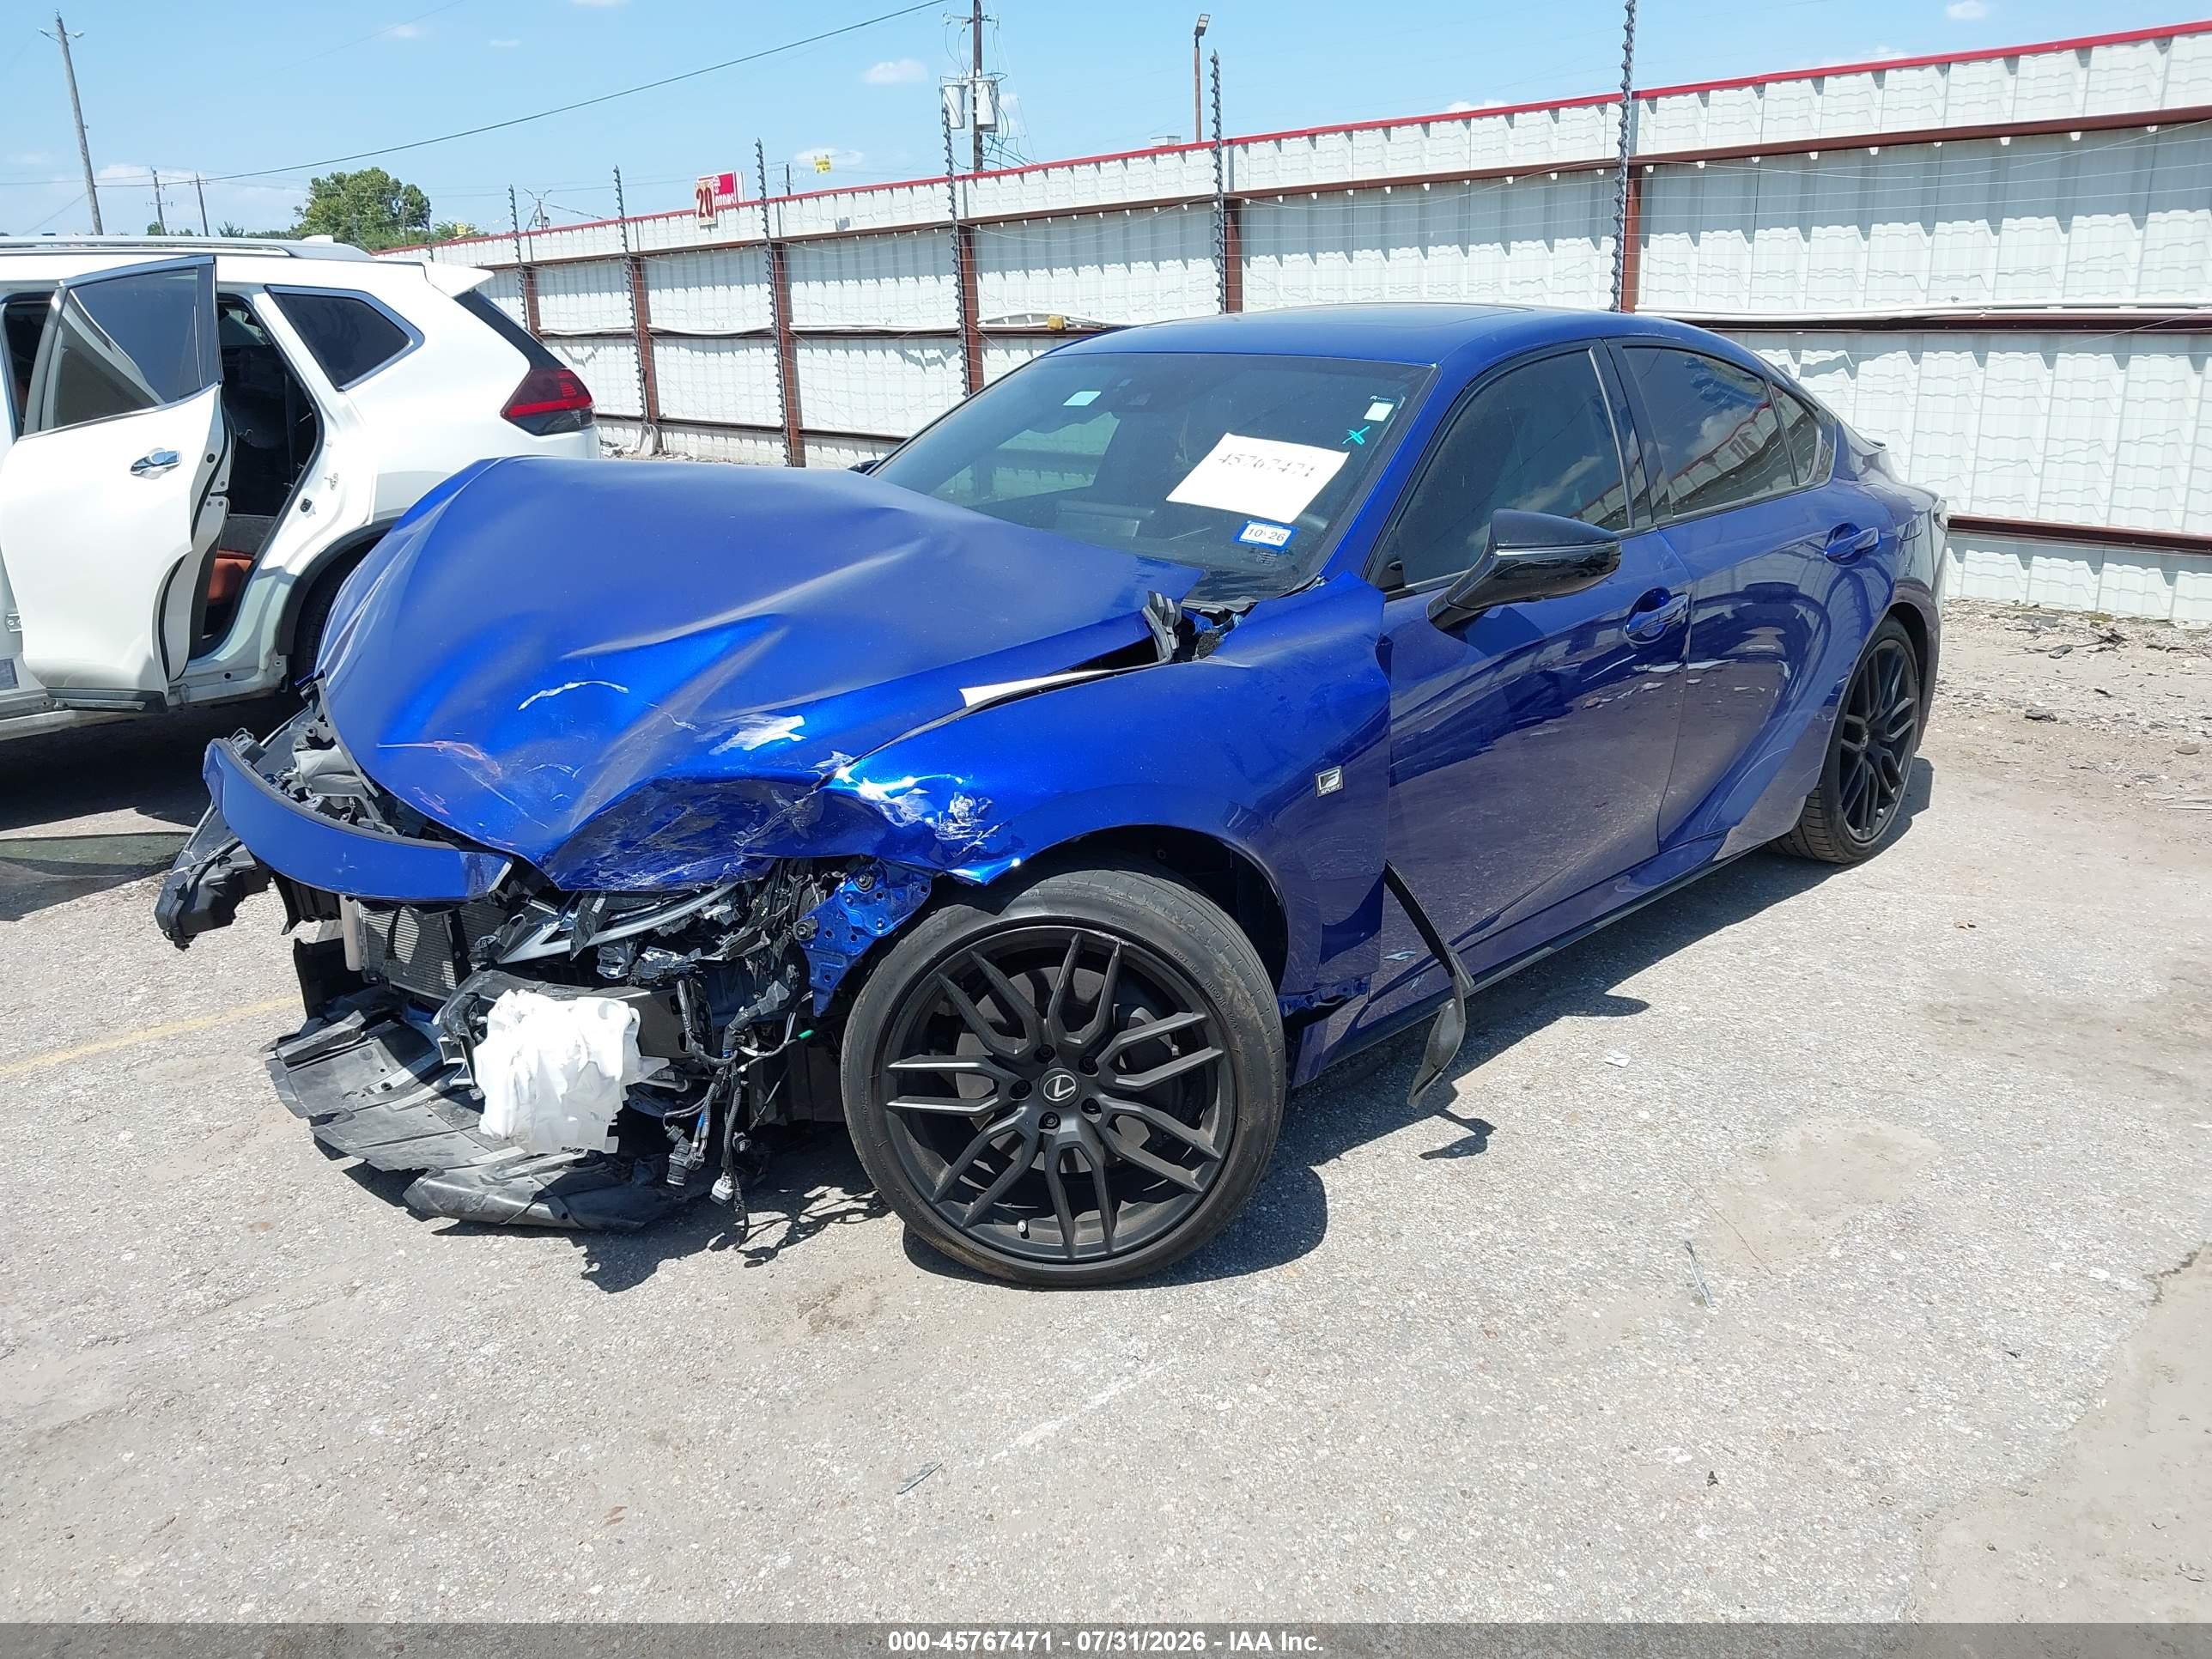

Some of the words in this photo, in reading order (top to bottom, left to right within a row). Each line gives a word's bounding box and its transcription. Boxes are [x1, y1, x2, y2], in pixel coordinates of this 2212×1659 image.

[696, 186, 714, 218] 20
[714, 192, 736, 207] OTORS
[1267, 531, 1286, 542] 26
